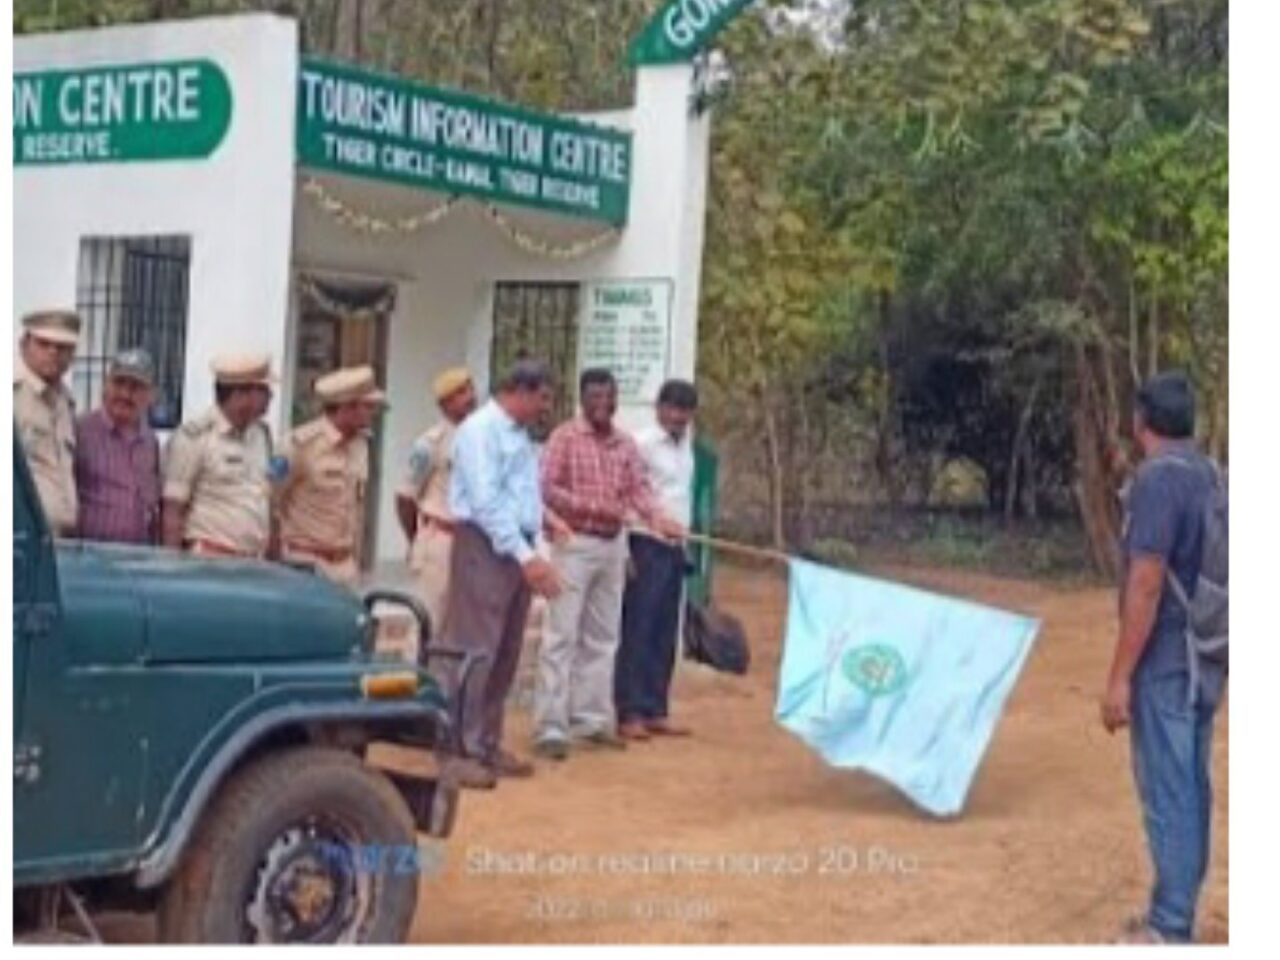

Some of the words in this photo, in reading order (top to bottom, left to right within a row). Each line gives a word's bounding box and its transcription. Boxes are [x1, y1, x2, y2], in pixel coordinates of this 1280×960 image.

[58, 67, 202, 127] CENTRE
[301, 71, 407, 138] TOURISM
[410, 96, 543, 168] INFORMATION
[549, 130, 626, 181] CENTRE
